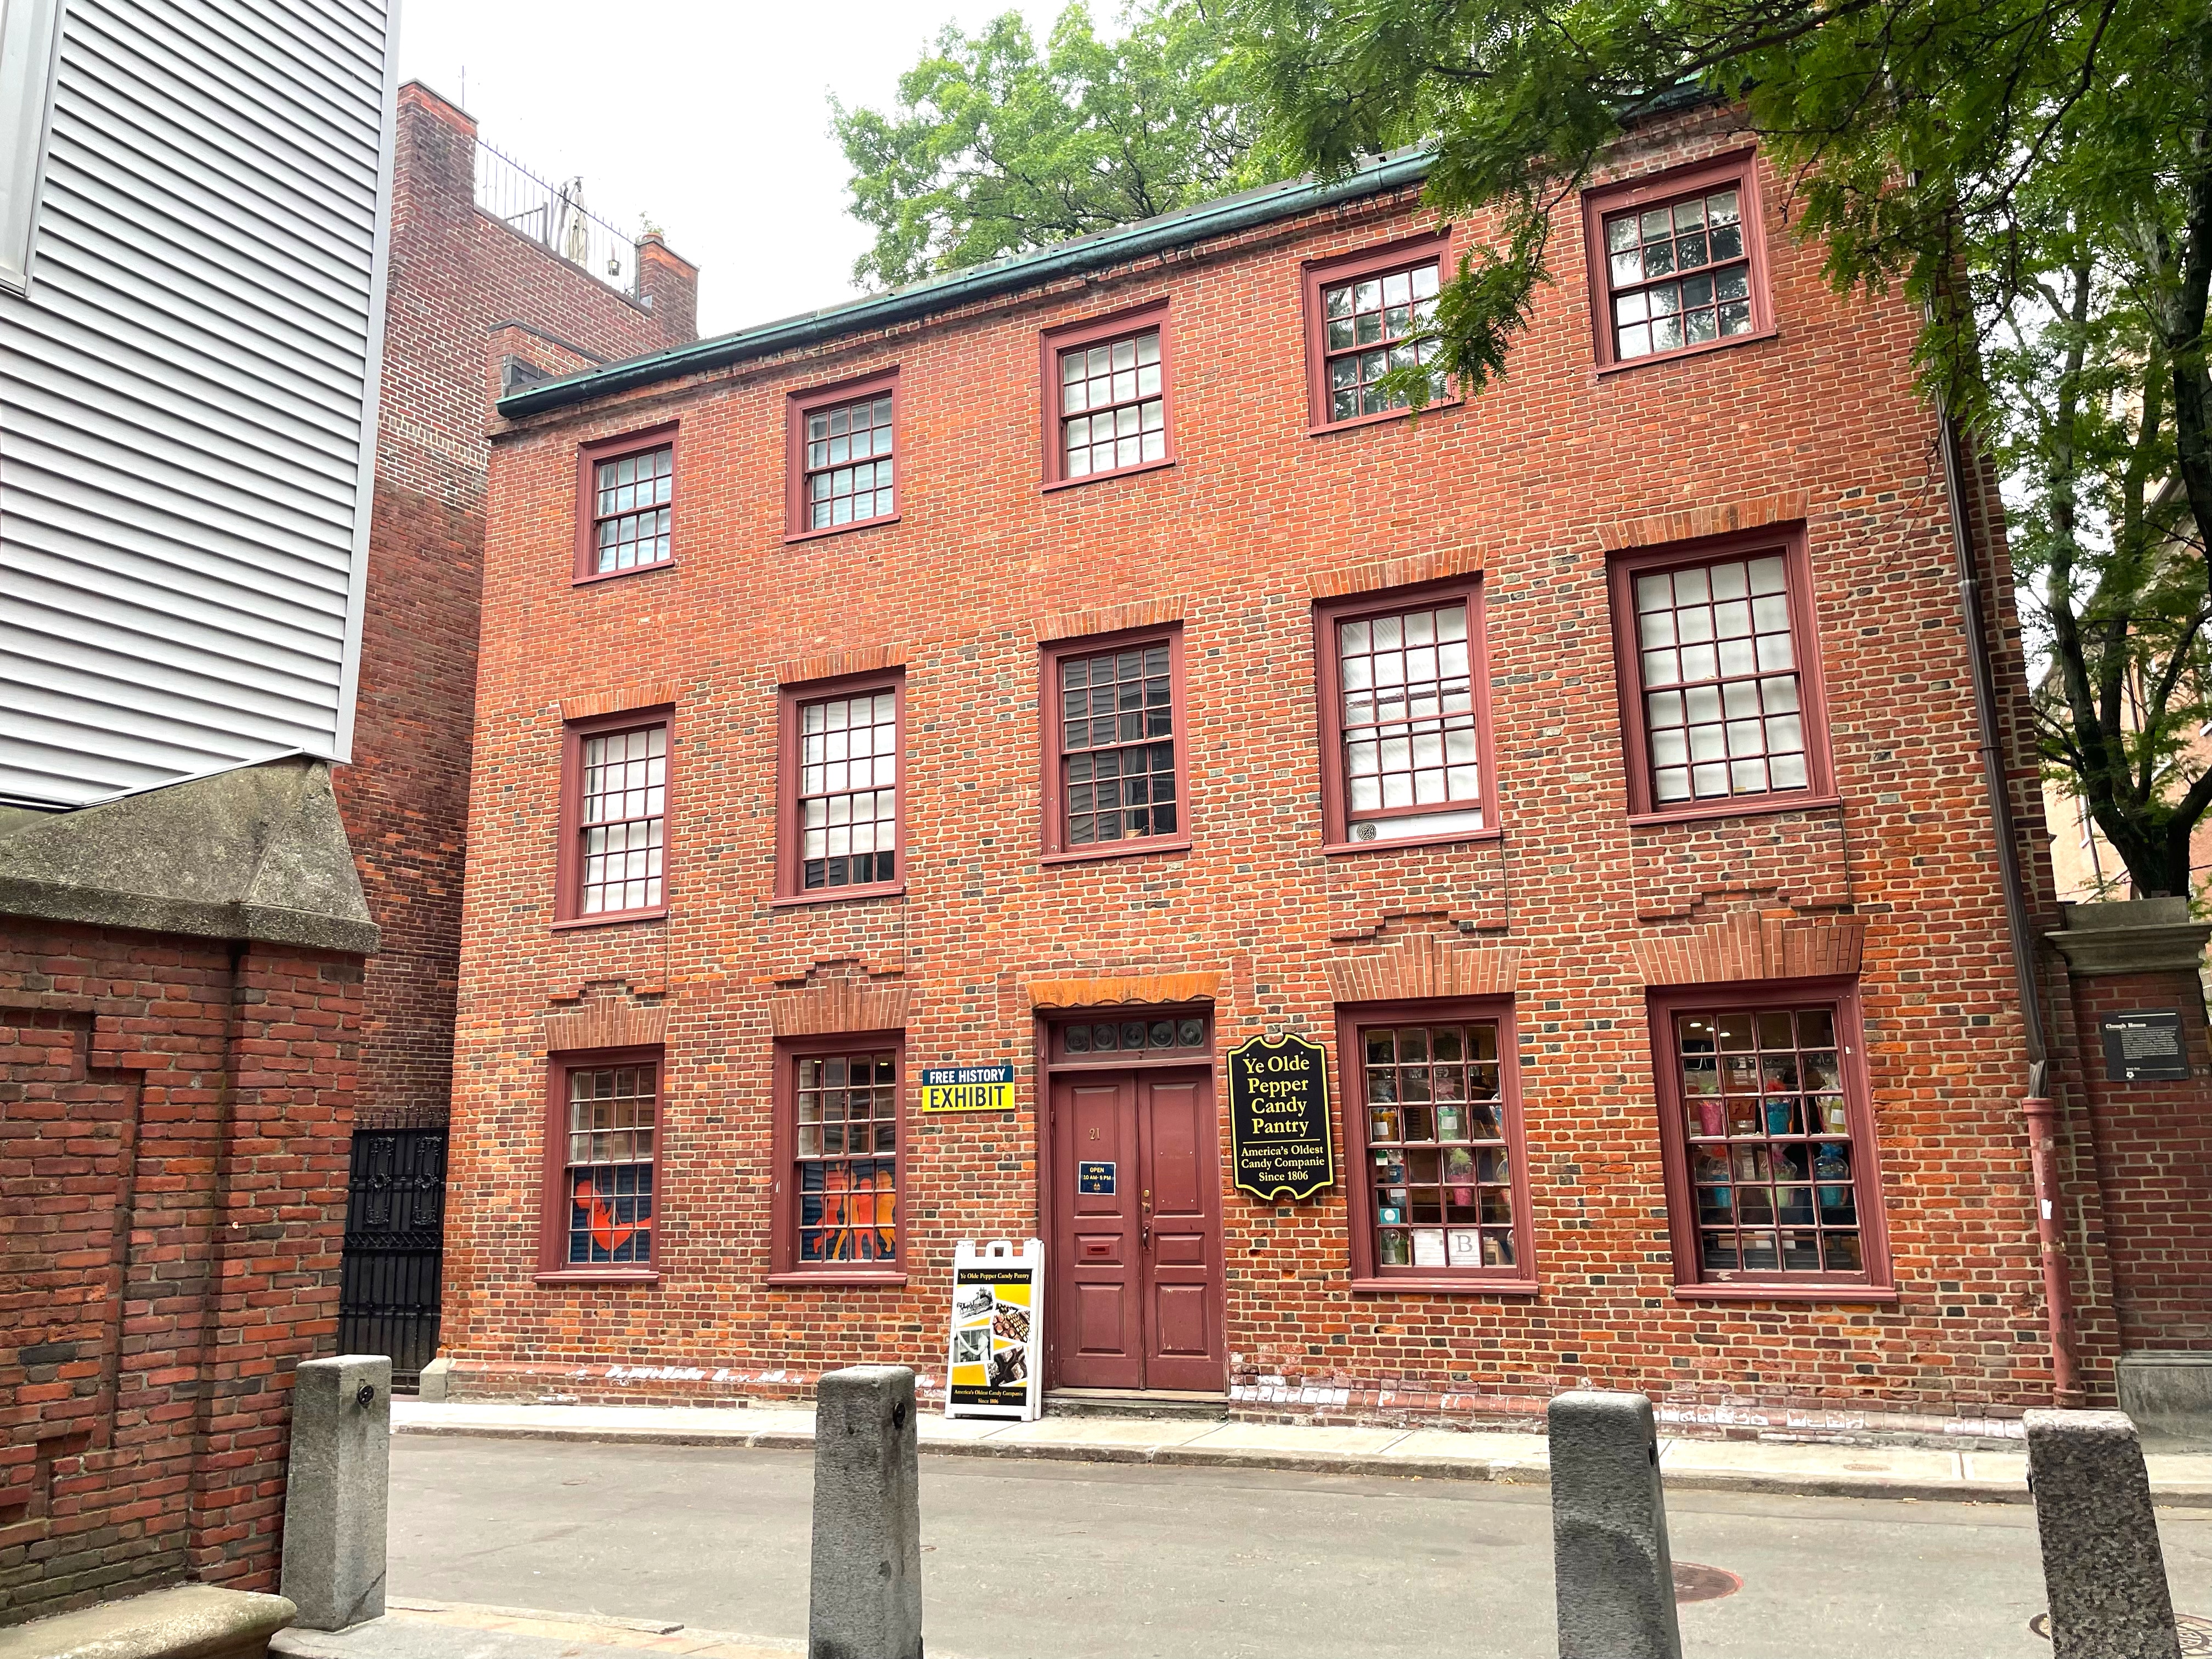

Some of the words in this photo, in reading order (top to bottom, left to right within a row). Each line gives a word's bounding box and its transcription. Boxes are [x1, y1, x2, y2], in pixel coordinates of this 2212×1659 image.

[1243, 1058, 1264, 1074] Ye
[1267, 1054, 1310, 1072] Olde
[930, 1070, 955, 1084] FREE
[958, 1068, 1006, 1082] HISTORY
[1247, 1077, 1308, 1098] Pepper
[930, 1085, 1006, 1108] EXHIBIT
[1251, 1096, 1307, 1117] Candy
[1089, 1128, 1100, 1141] 21
[1251, 1118, 1310, 1137] Pantry
[1241, 1146, 1288, 1157] America's
[1291, 1144, 1324, 1155] Oldest
[1241, 1158, 1272, 1170] Candy
[1274, 1156, 1325, 1169] Companie
[1259, 1172, 1285, 1182] Since
[1287, 1170, 1308, 1181] 1806
[1455, 1235, 1473, 1252] B
